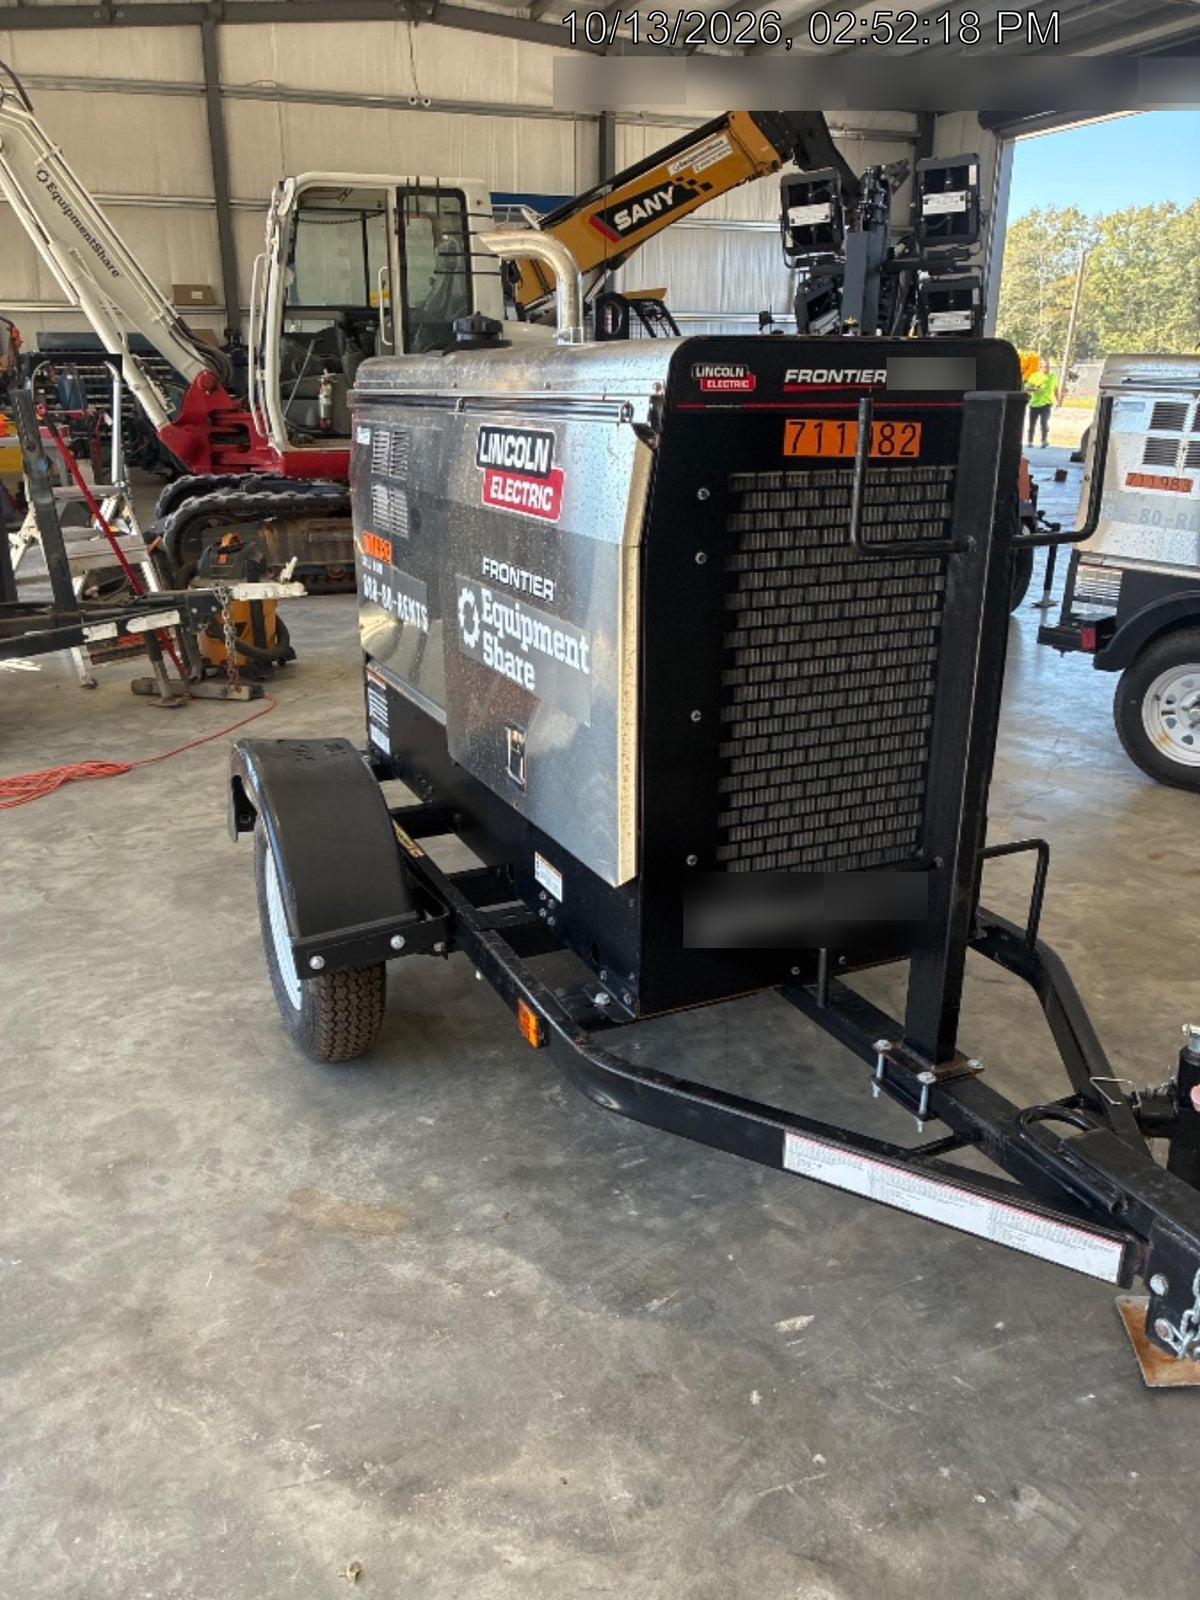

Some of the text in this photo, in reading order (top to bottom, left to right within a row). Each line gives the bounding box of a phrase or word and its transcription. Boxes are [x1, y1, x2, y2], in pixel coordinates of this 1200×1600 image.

[46, 182, 119, 278] EquipmentShare
[614, 185, 674, 231] SANY
[696, 366, 887, 384] LINCOLN FRONTIER
[706, 379, 750, 388] ELECTRIC
[480, 431, 550, 473] LINCOLN
[788, 421, 917, 456] 71182
[490, 475, 553, 511] ELECTRIC
[482, 556, 555, 602] FRONTIER
[481, 587, 590, 675] Equipment
[482, 630, 536, 691] Share
